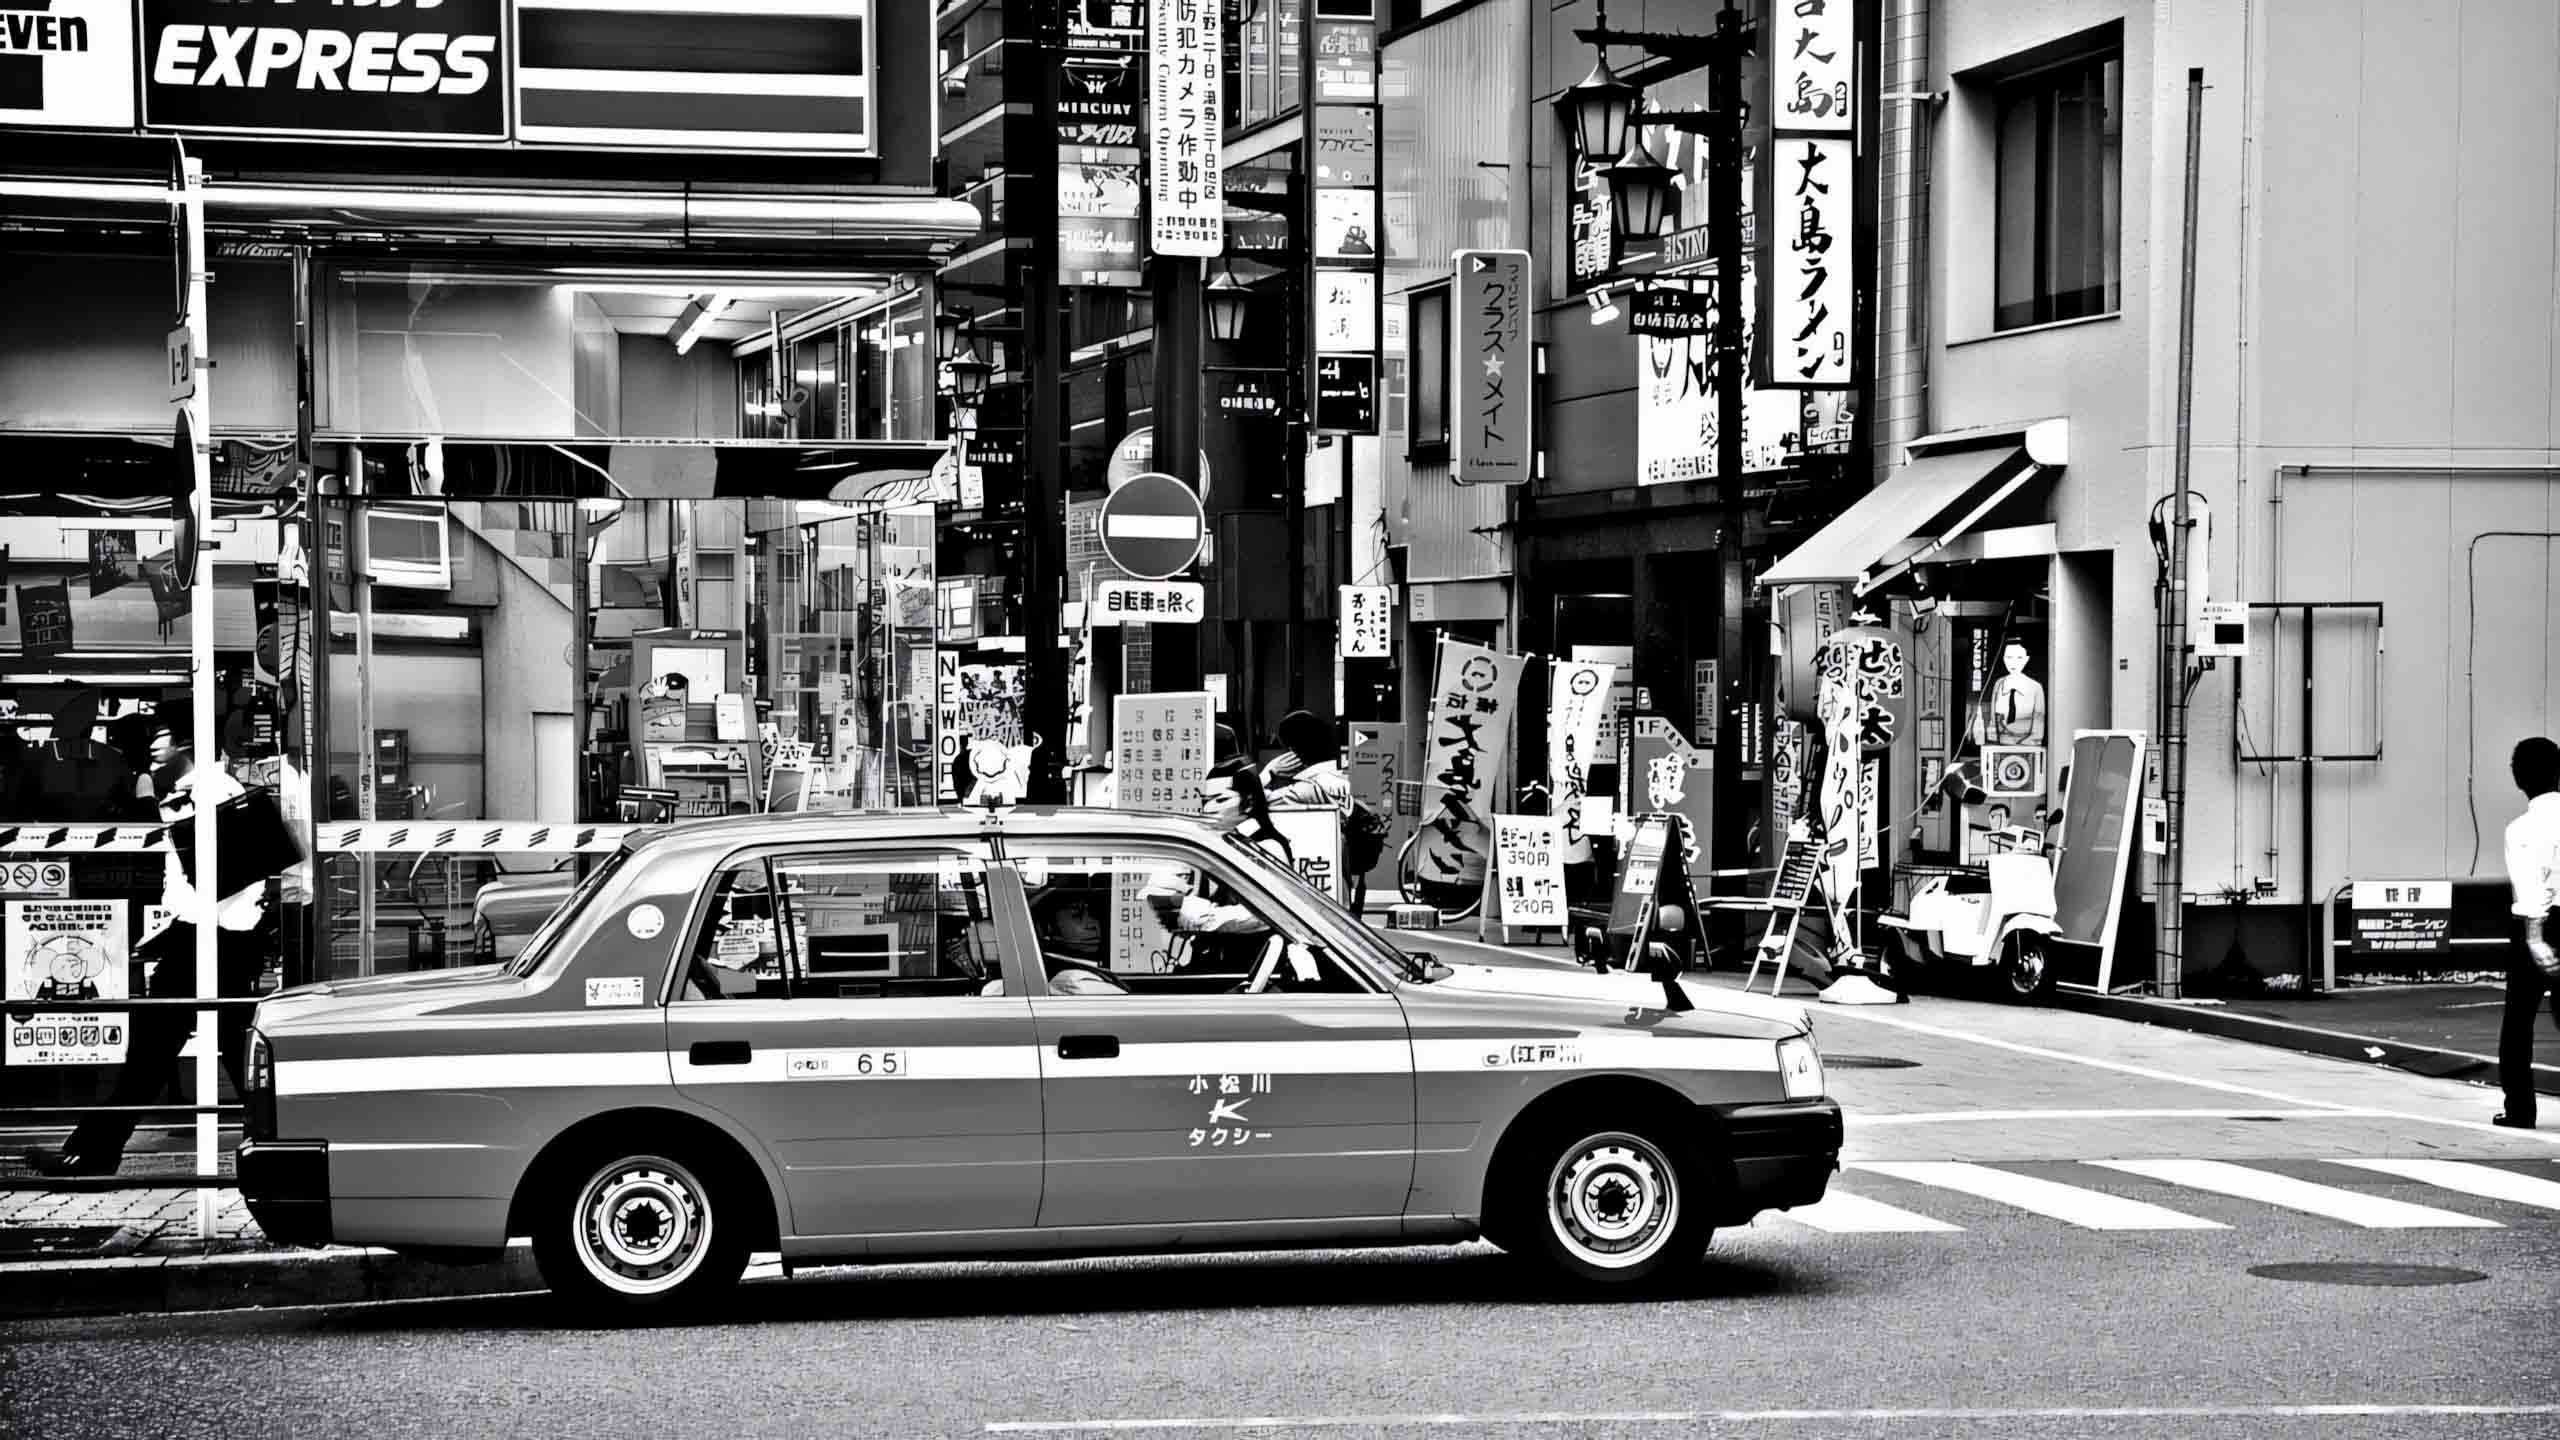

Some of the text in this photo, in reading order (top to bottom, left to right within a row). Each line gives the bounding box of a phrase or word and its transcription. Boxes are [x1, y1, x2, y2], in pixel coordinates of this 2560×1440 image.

[154, 24, 496, 94] EXPRESS
[1792, 141, 1833, 380] 大島ラーメン
[1108, 591, 1194, 612] 自転車を除く
[1637, 719, 1660, 735] 1F
[1508, 851, 1549, 866] 390円
[1513, 899, 1554, 915] 290円
[1188, 1073, 1271, 1094] 小松川
[1188, 1127, 1272, 1146] タクシー
